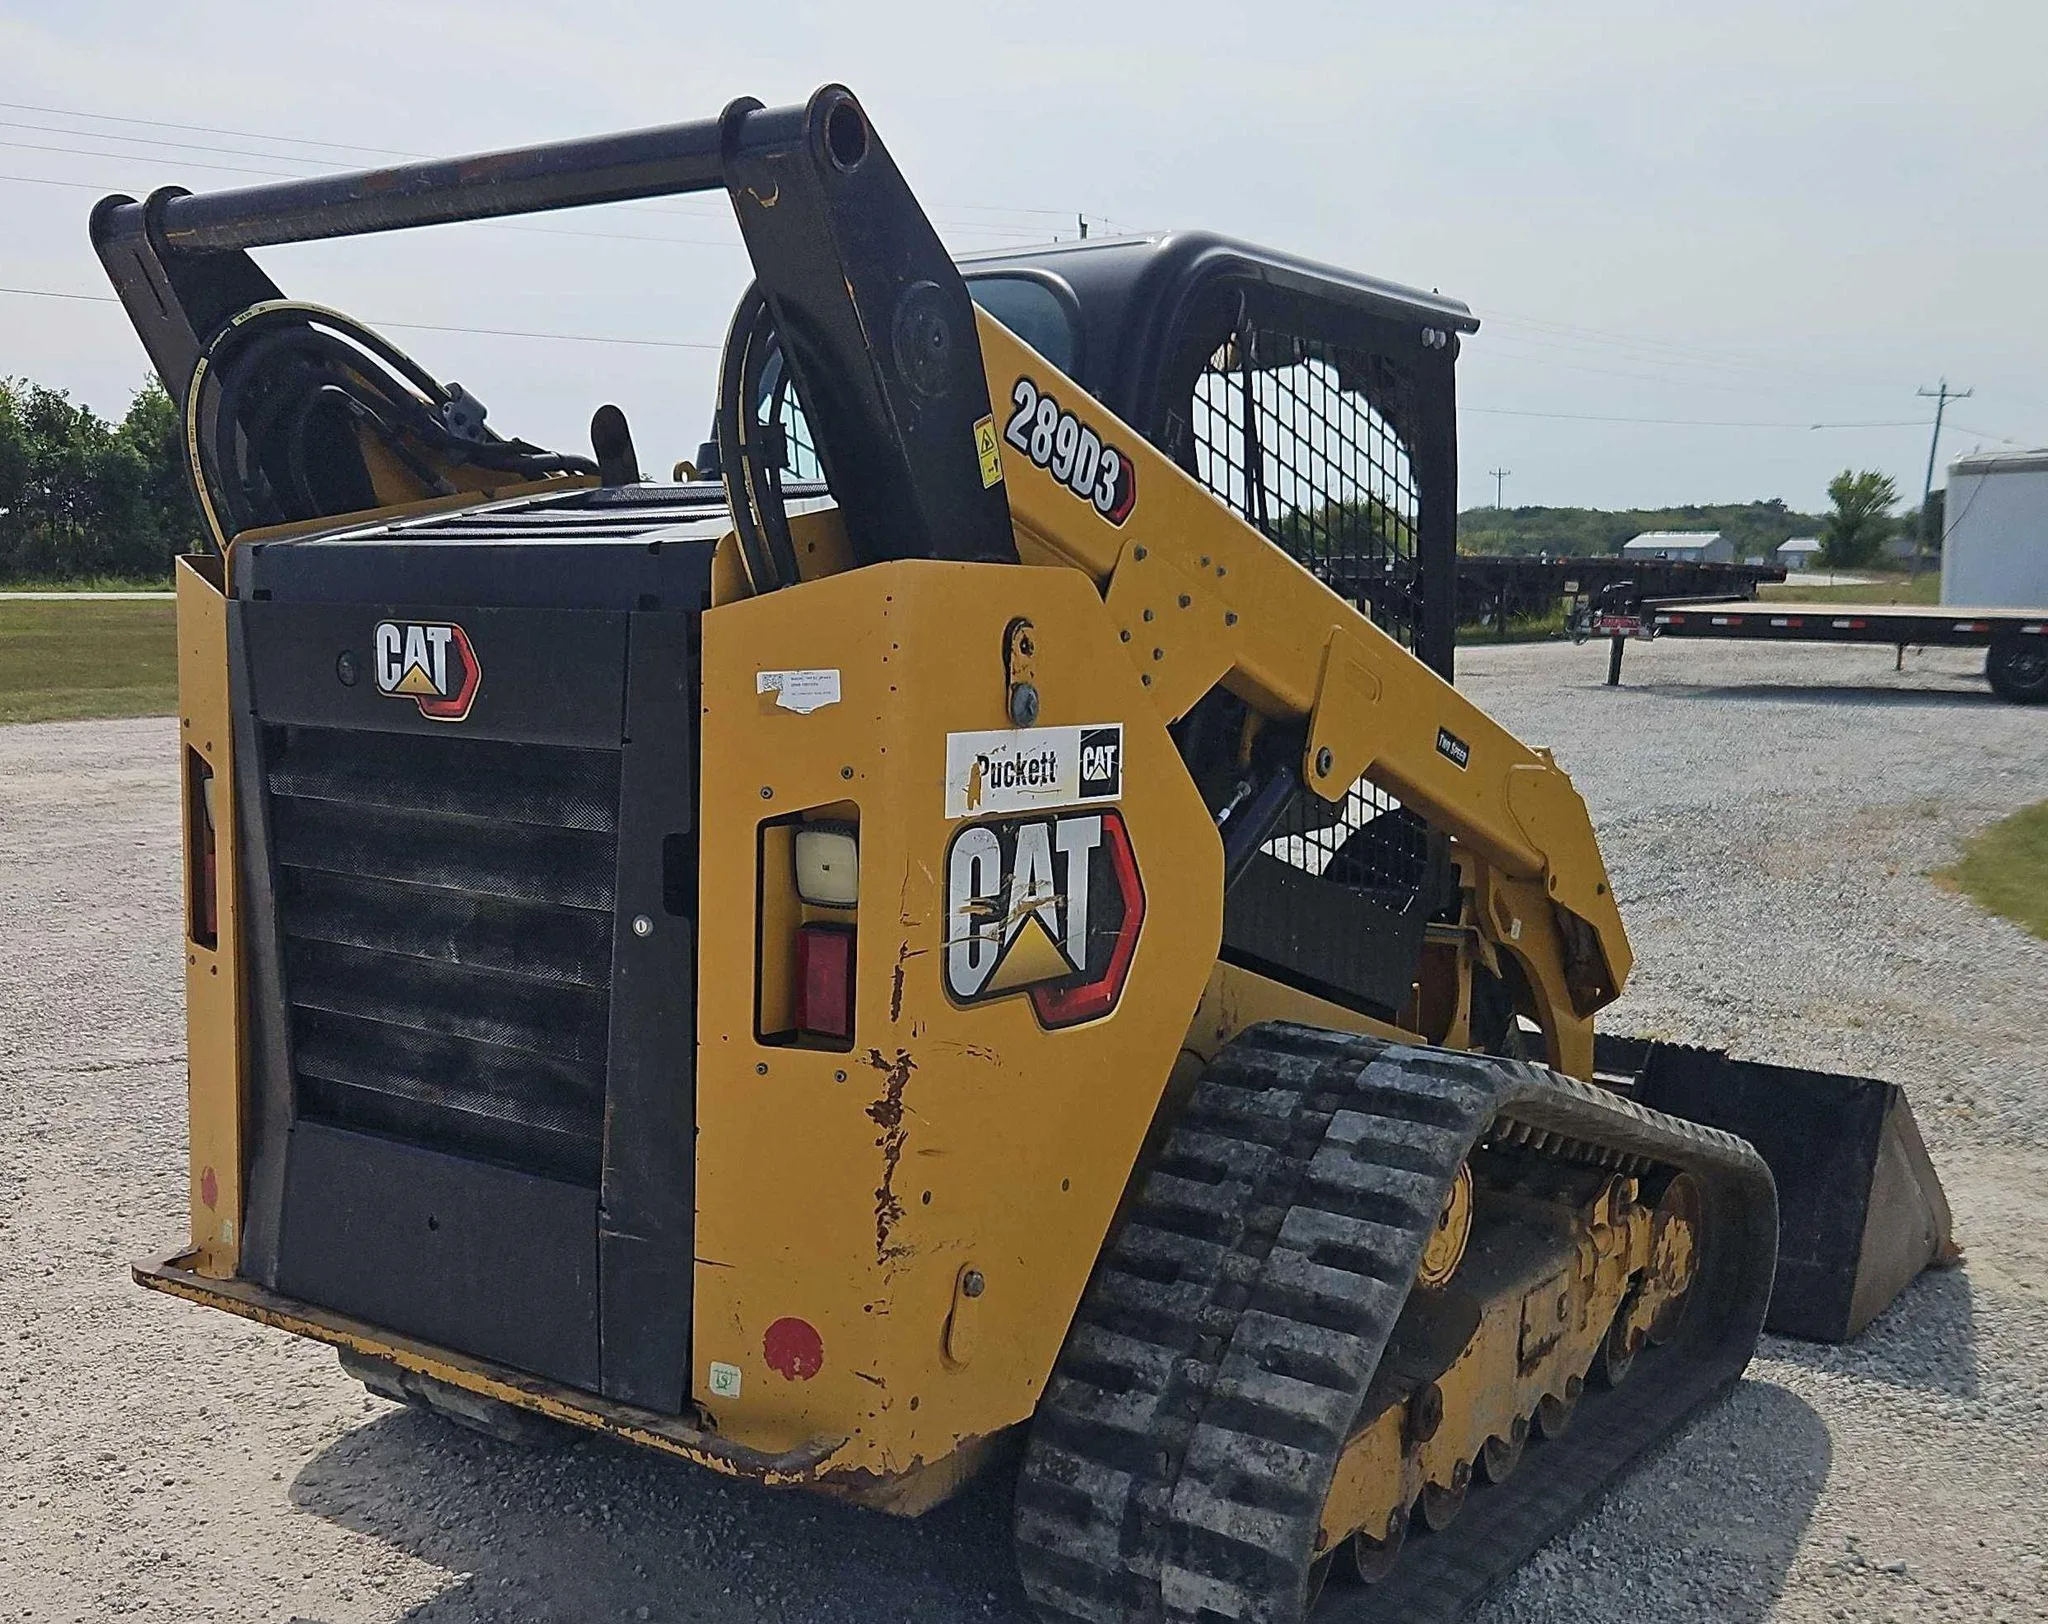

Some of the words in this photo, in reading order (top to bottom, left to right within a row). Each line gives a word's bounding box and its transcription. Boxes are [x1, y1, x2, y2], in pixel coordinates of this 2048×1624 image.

[1006, 381, 1120, 512] 289D3
[376, 623, 452, 696] CAT
[975, 750, 1056, 789] Puckett
[1082, 744, 1117, 781] CAT
[949, 815, 1101, 997] CAT
